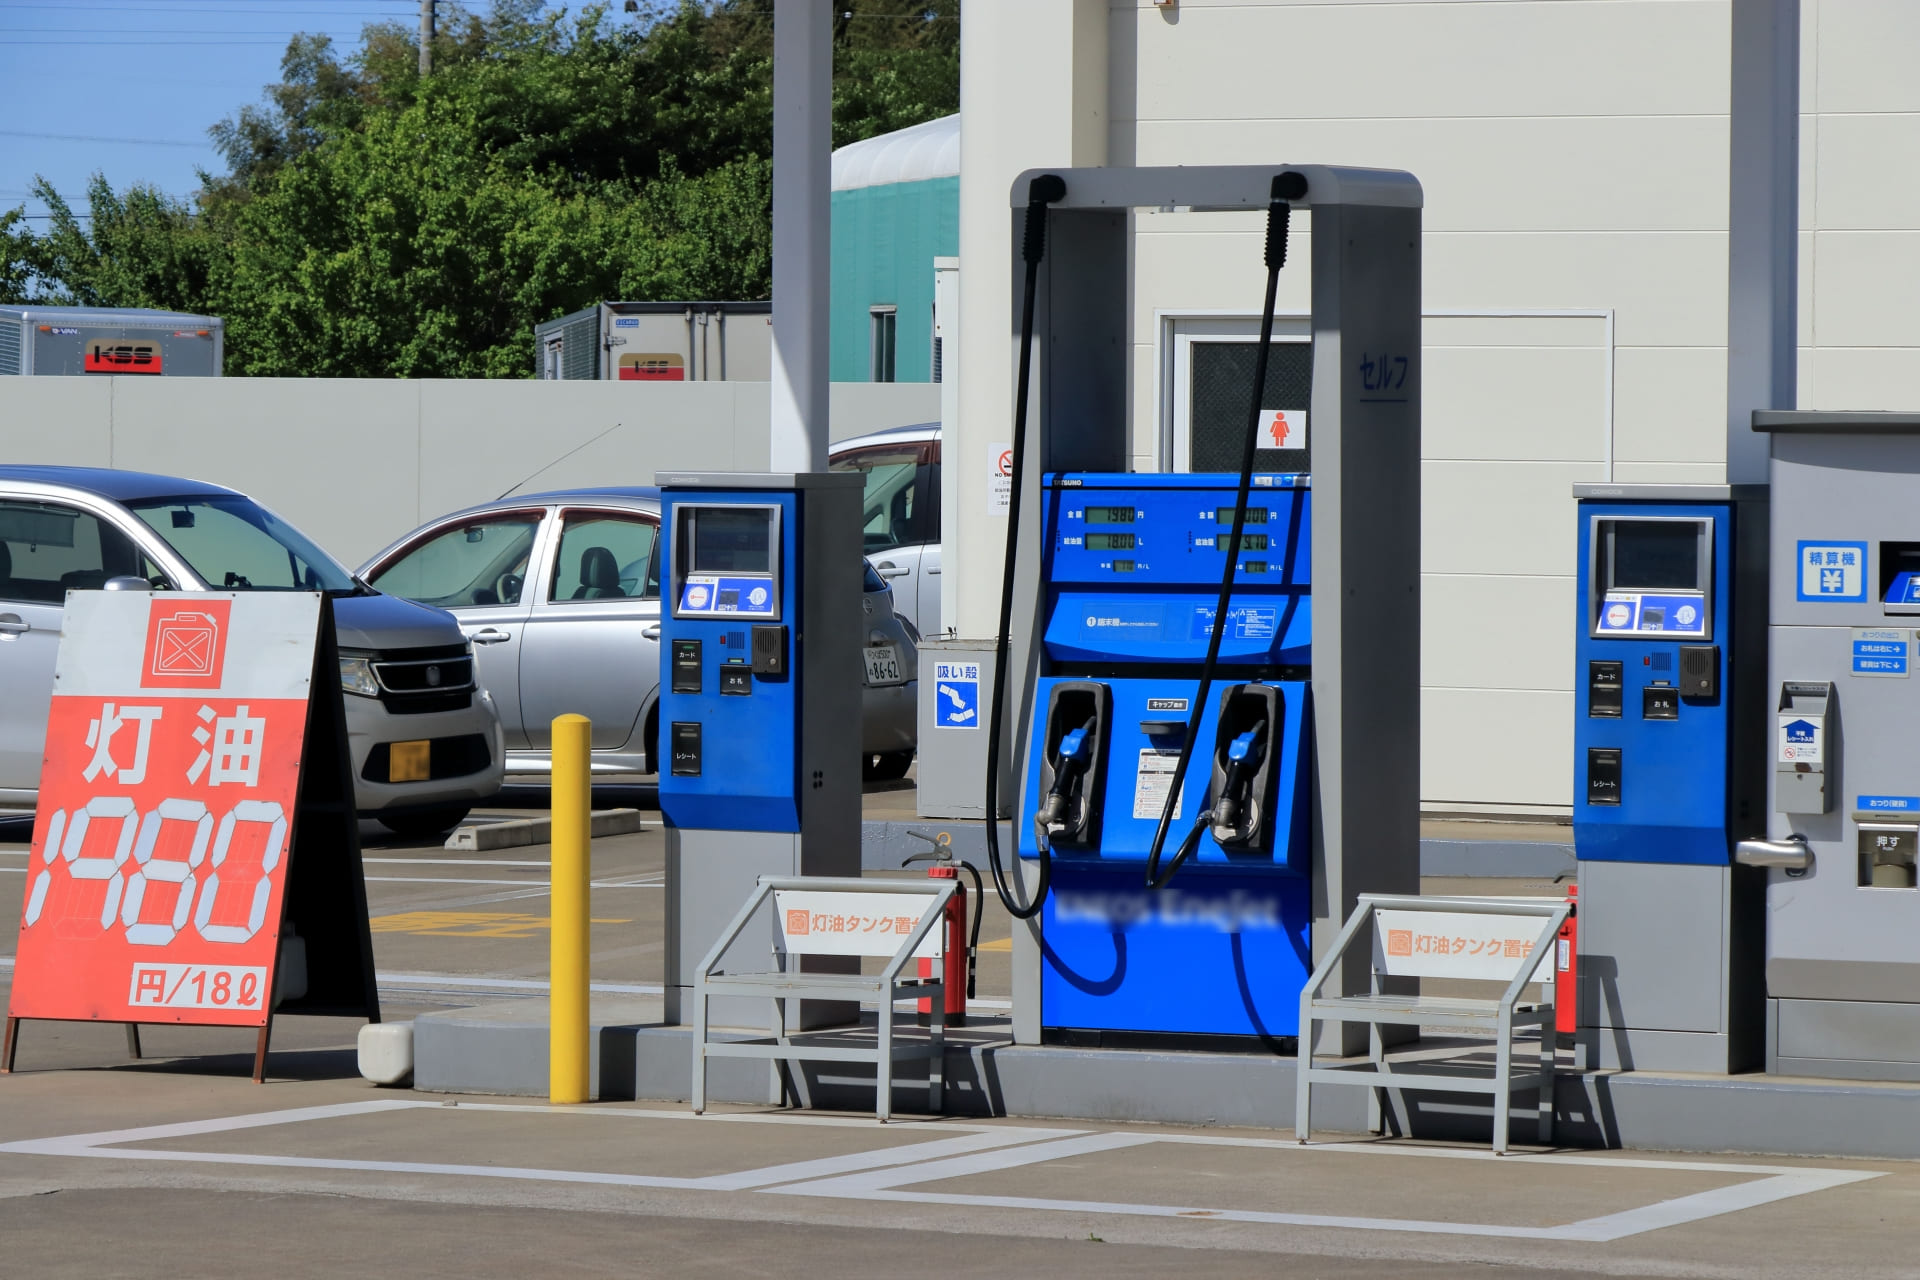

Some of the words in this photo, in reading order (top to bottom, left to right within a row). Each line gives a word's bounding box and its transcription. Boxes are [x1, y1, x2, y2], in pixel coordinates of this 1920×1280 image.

[94, 345, 153, 365] KSS
[1359, 352, 1408, 393] セルフ
[1138, 537, 1144, 546] L
[1271, 538, 1277, 547] L
[1809, 551, 1855, 566] 精算機
[937, 665, 978, 679] 吸い殻
[82, 703, 267, 788] 灯油
[1593, 780, 1616, 788] レシート
[1876, 835, 1901, 847] 押す
[25, 796, 288, 947] 1980
